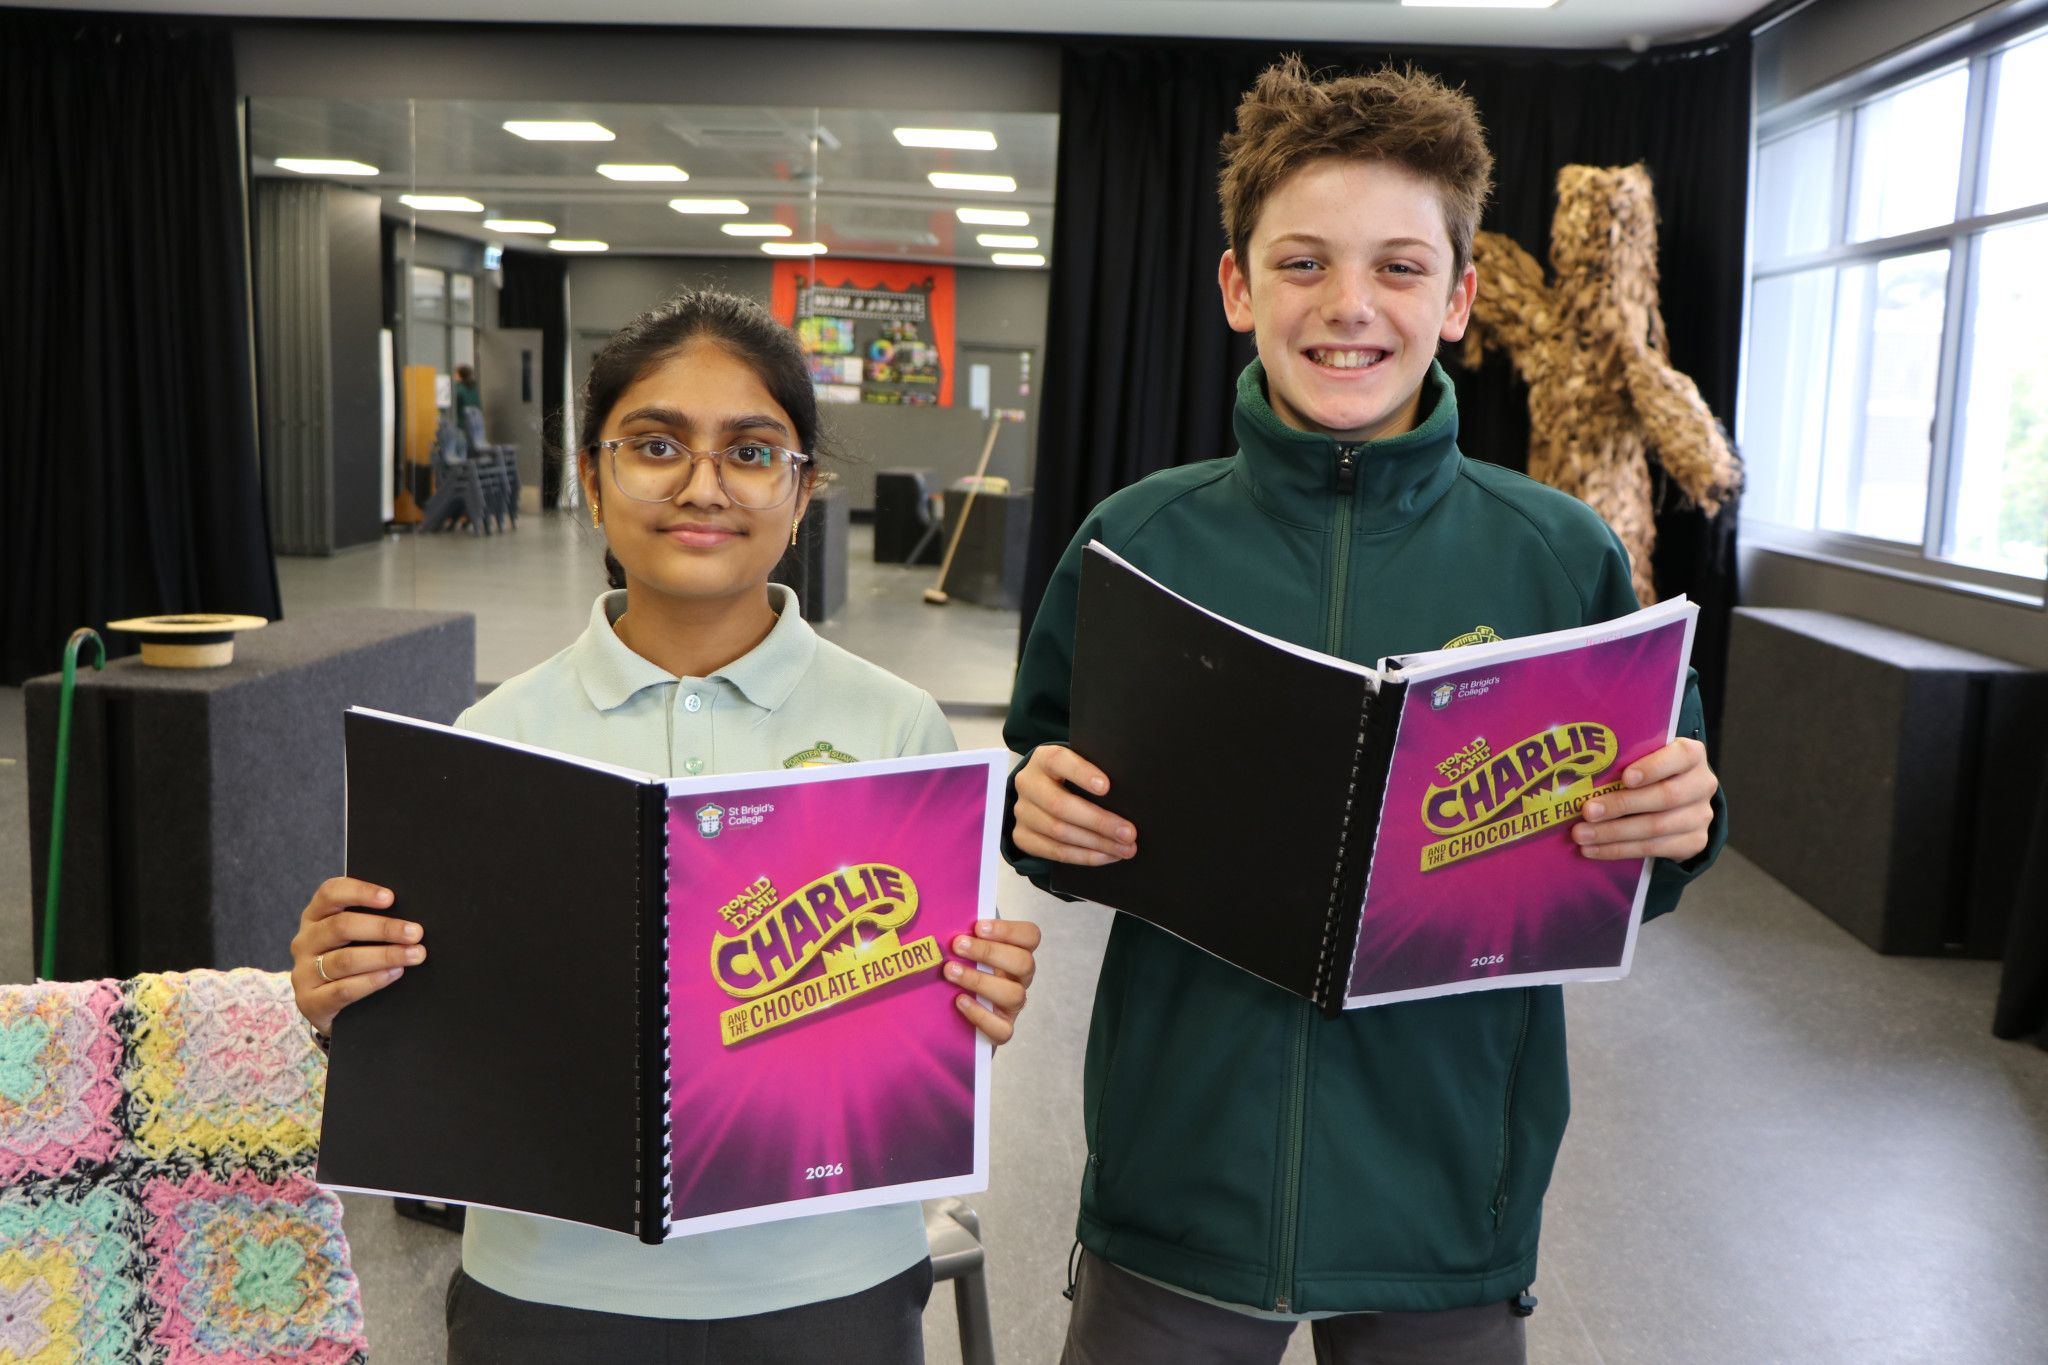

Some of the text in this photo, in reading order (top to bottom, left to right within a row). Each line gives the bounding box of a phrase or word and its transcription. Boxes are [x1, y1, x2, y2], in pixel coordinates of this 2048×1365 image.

[1459, 676, 1500, 690] St Brigid's
[1457, 686, 1489, 698] College
[1435, 737, 1487, 775] ROALD
[1426, 725, 1606, 828] CHARLIE
[728, 804, 775, 816] St Brigid's
[728, 815, 764, 826] College
[1448, 808, 1550, 859] CHOCOLATE
[1427, 843, 1447, 857] AND
[1428, 852, 1446, 866] THE
[717, 876, 771, 921] ROALD
[718, 868, 906, 990] CHARLIE
[1470, 953, 1505, 968] 2026
[750, 941, 934, 1028] CHOCOLATE FACTORY
[728, 1008, 748, 1026] AND
[729, 1018, 750, 1037] THE
[806, 1163, 843, 1180] 2026
